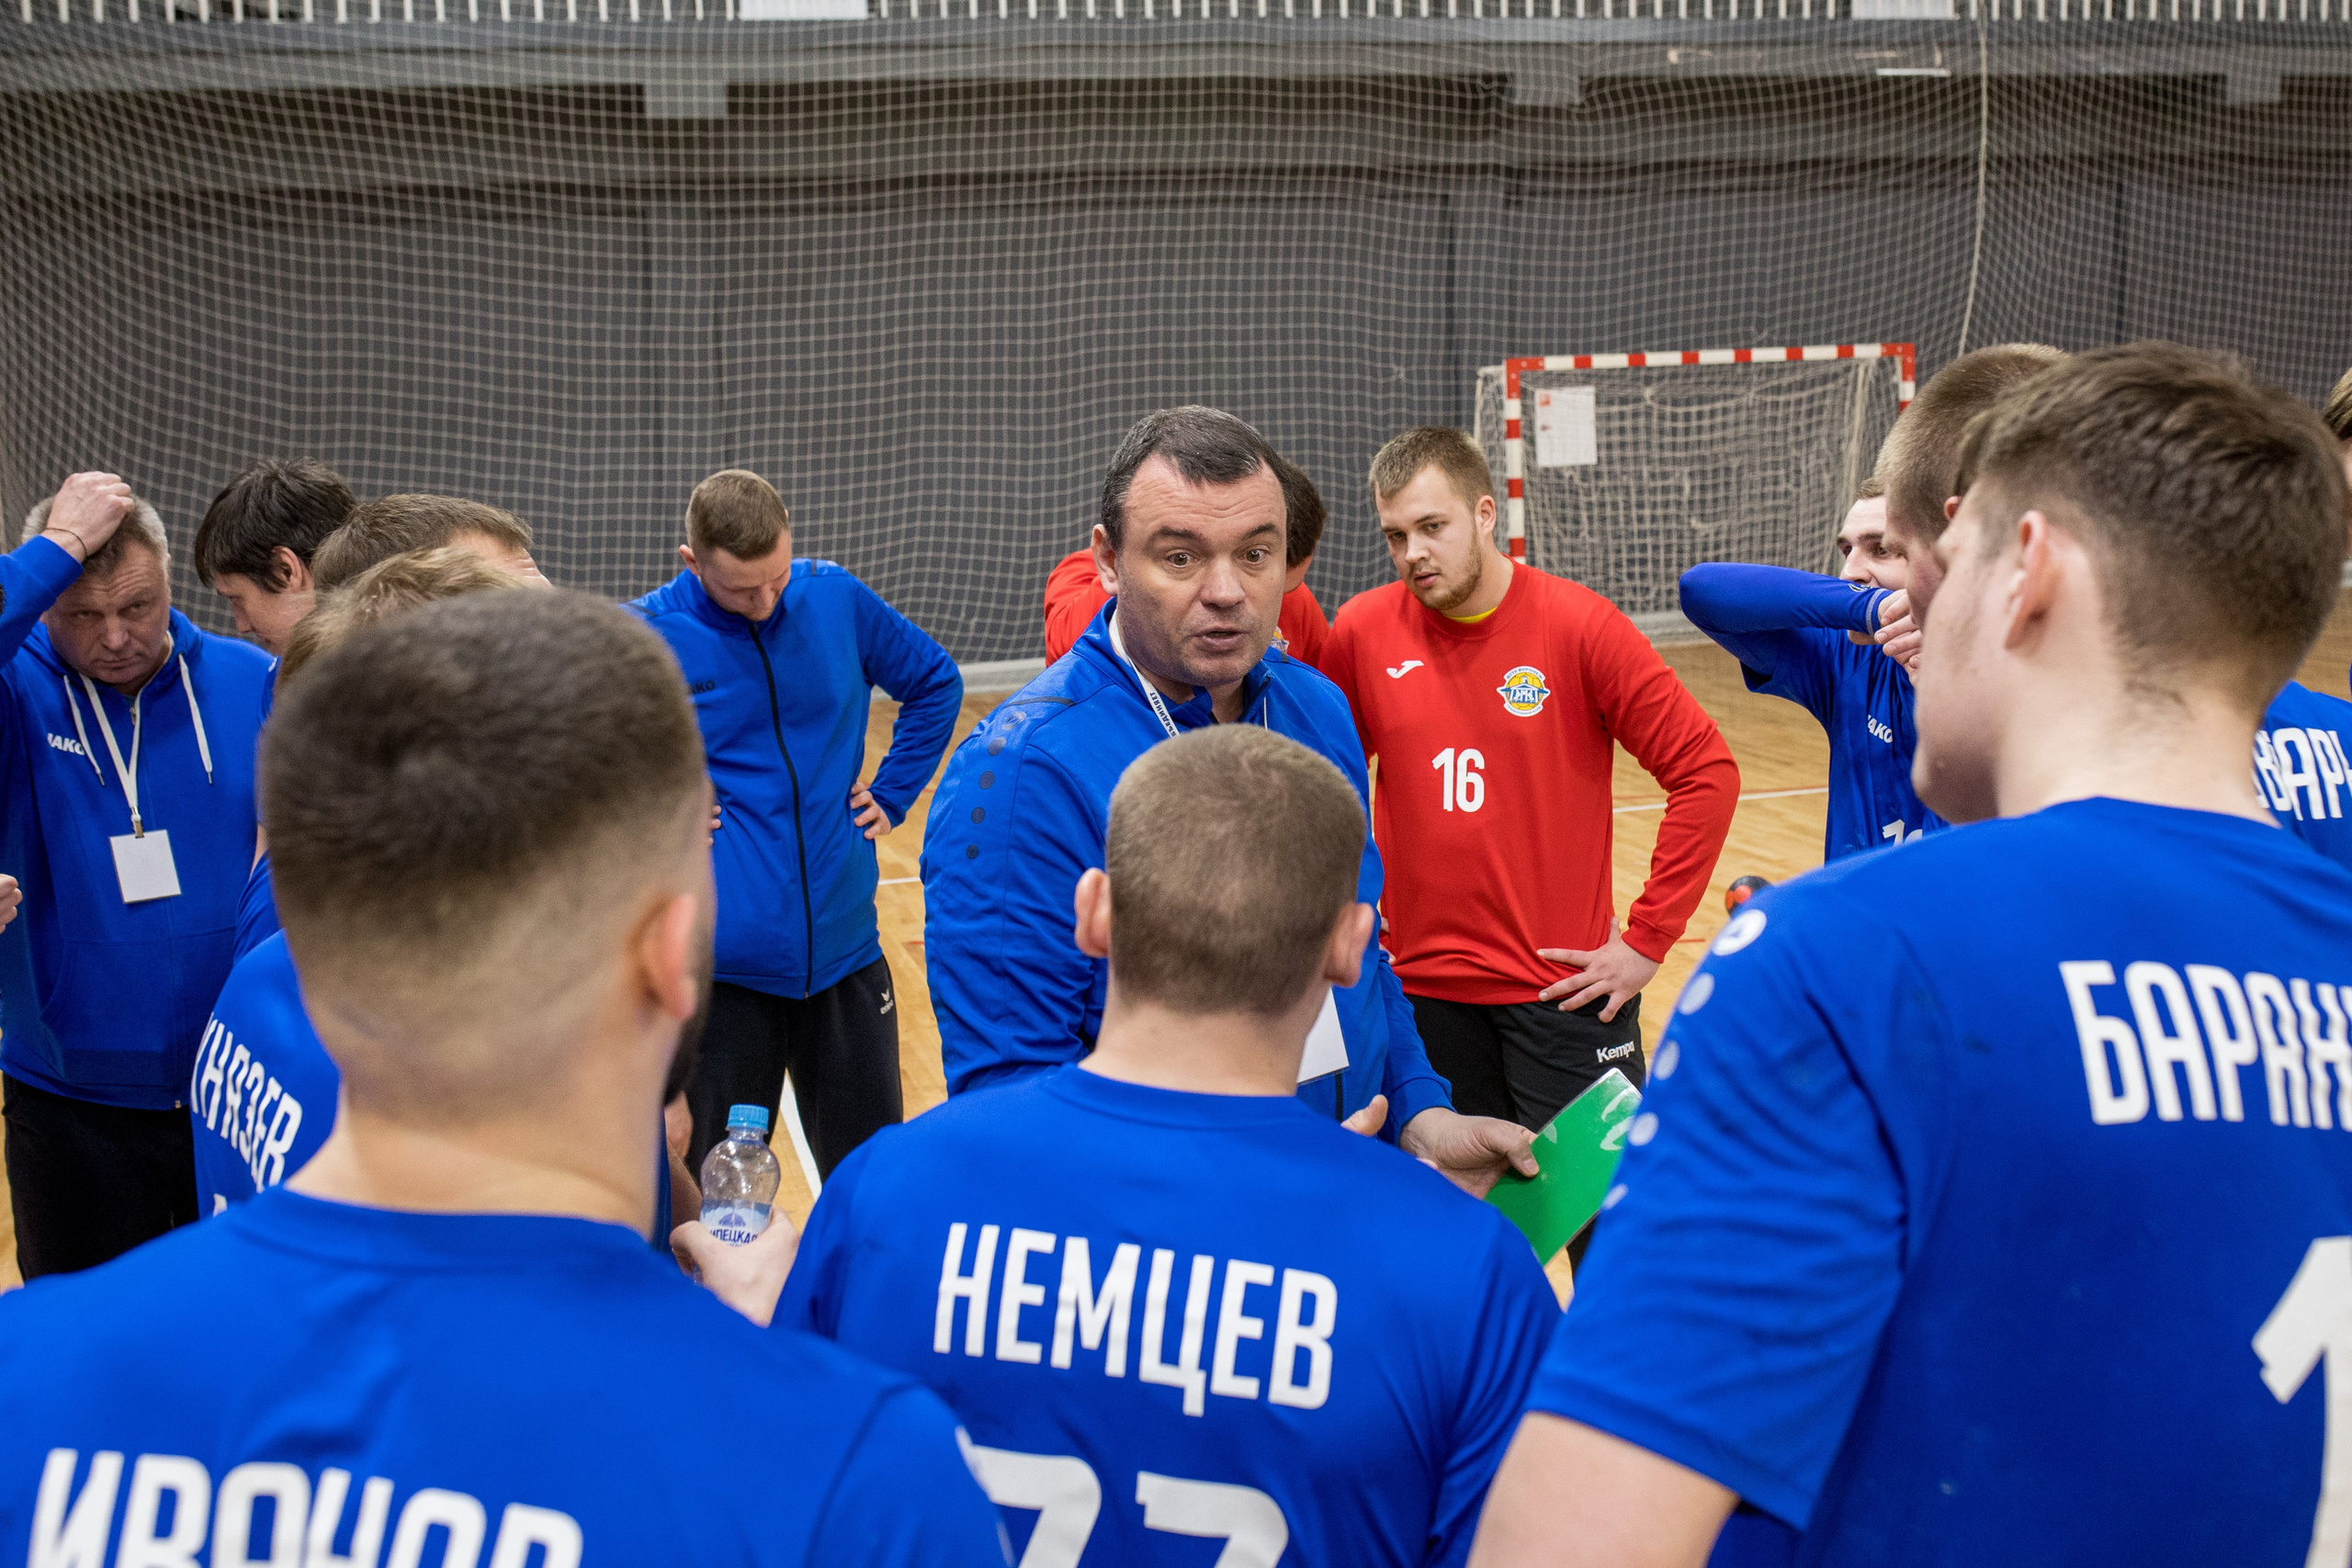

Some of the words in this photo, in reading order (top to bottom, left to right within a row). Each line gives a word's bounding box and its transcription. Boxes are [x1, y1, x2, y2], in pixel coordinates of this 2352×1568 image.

[1431, 748, 1485, 813] 16
[1868, 714, 1894, 743] AKO
[2058, 959, 2352, 1134] БАРАН
[933, 1223, 1338, 1417] НЕМЦЕВ
